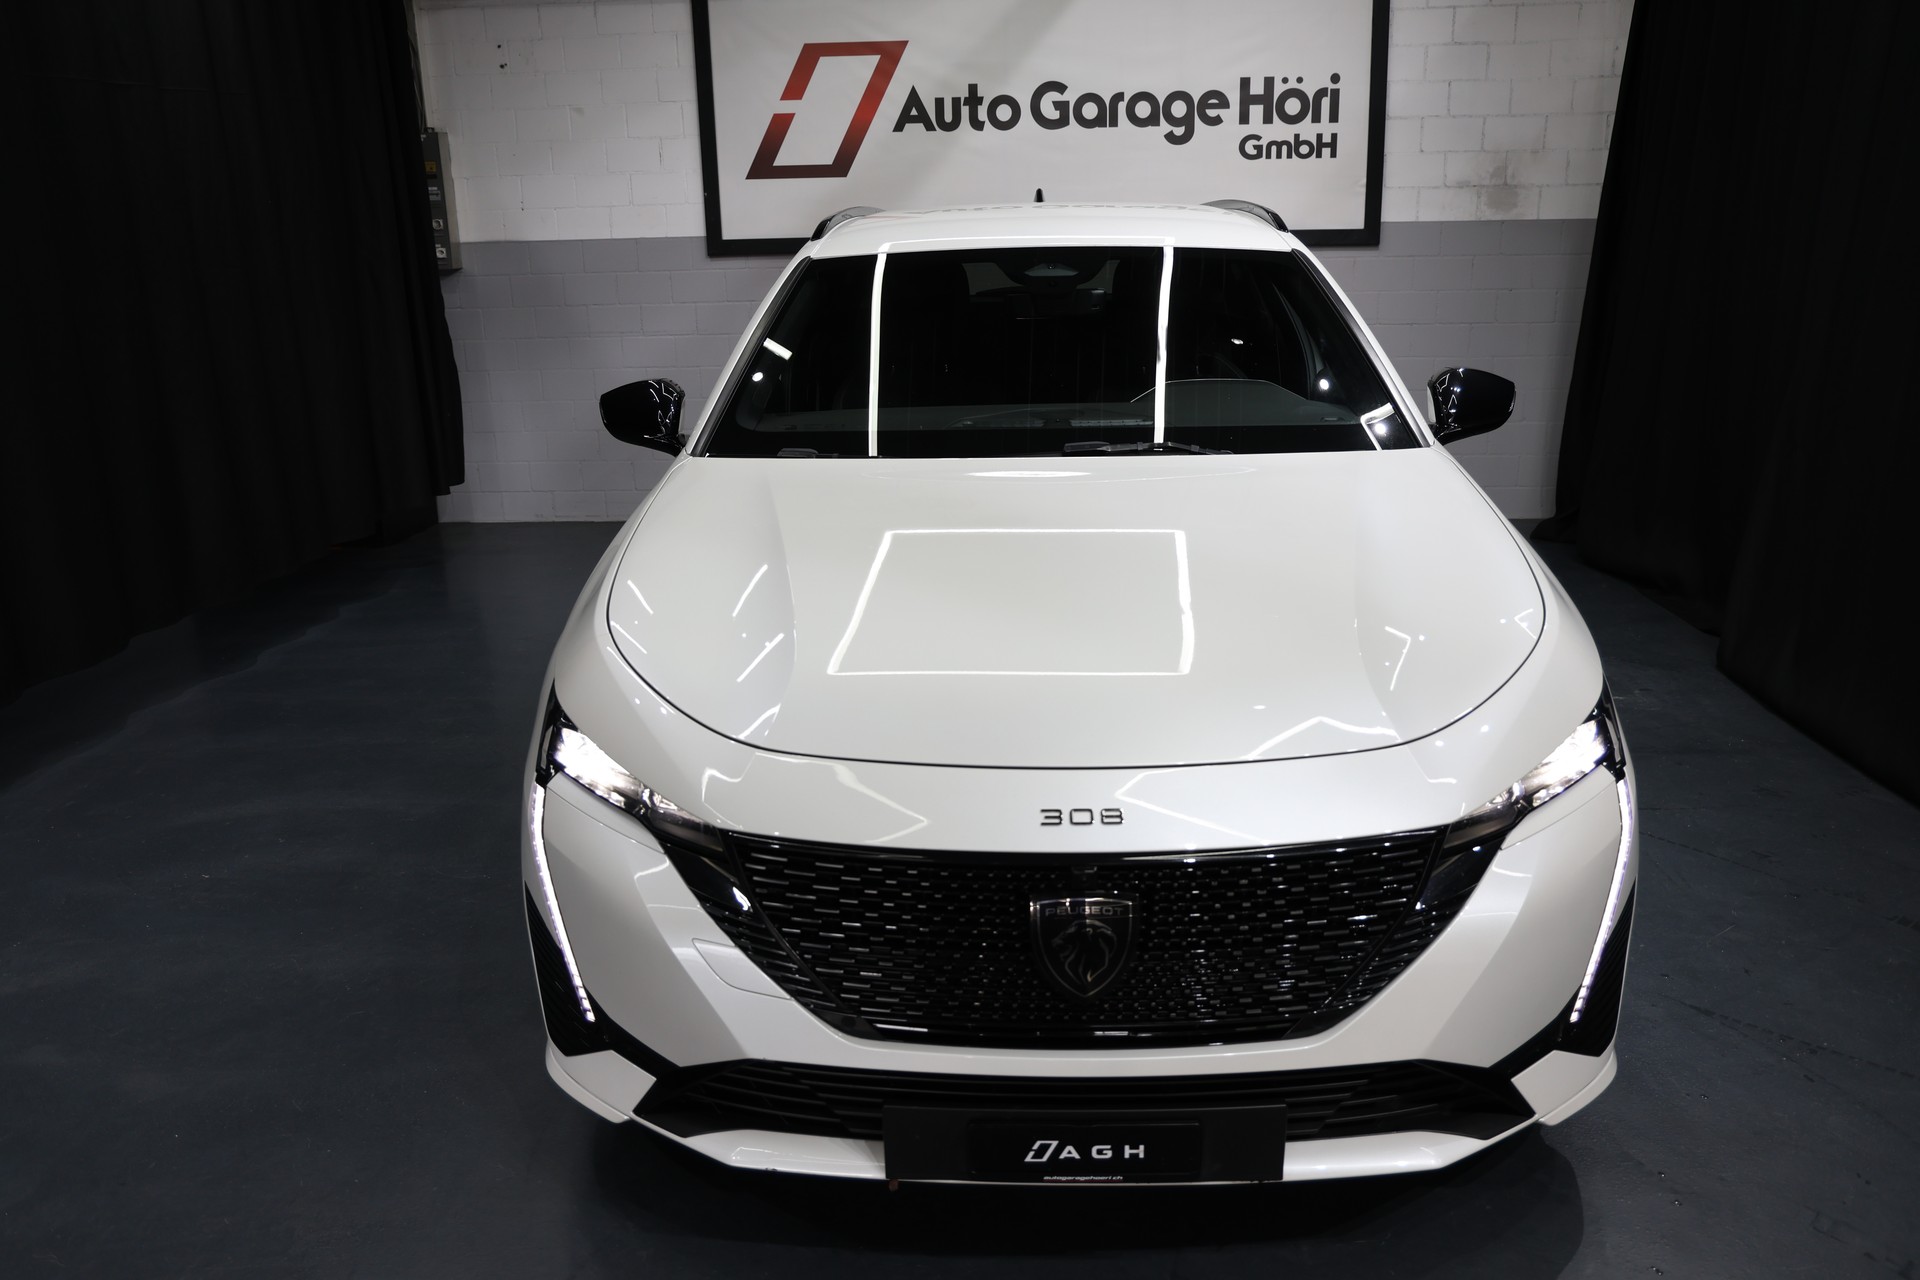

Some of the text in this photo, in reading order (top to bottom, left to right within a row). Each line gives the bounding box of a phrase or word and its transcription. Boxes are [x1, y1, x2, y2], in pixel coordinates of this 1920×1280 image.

[892, 73, 1340, 146] Auto Garage Höri
[1239, 133, 1337, 160] GmbH
[1040, 808, 1124, 826] 308
[1045, 905, 1124, 917] PEUGEOT
